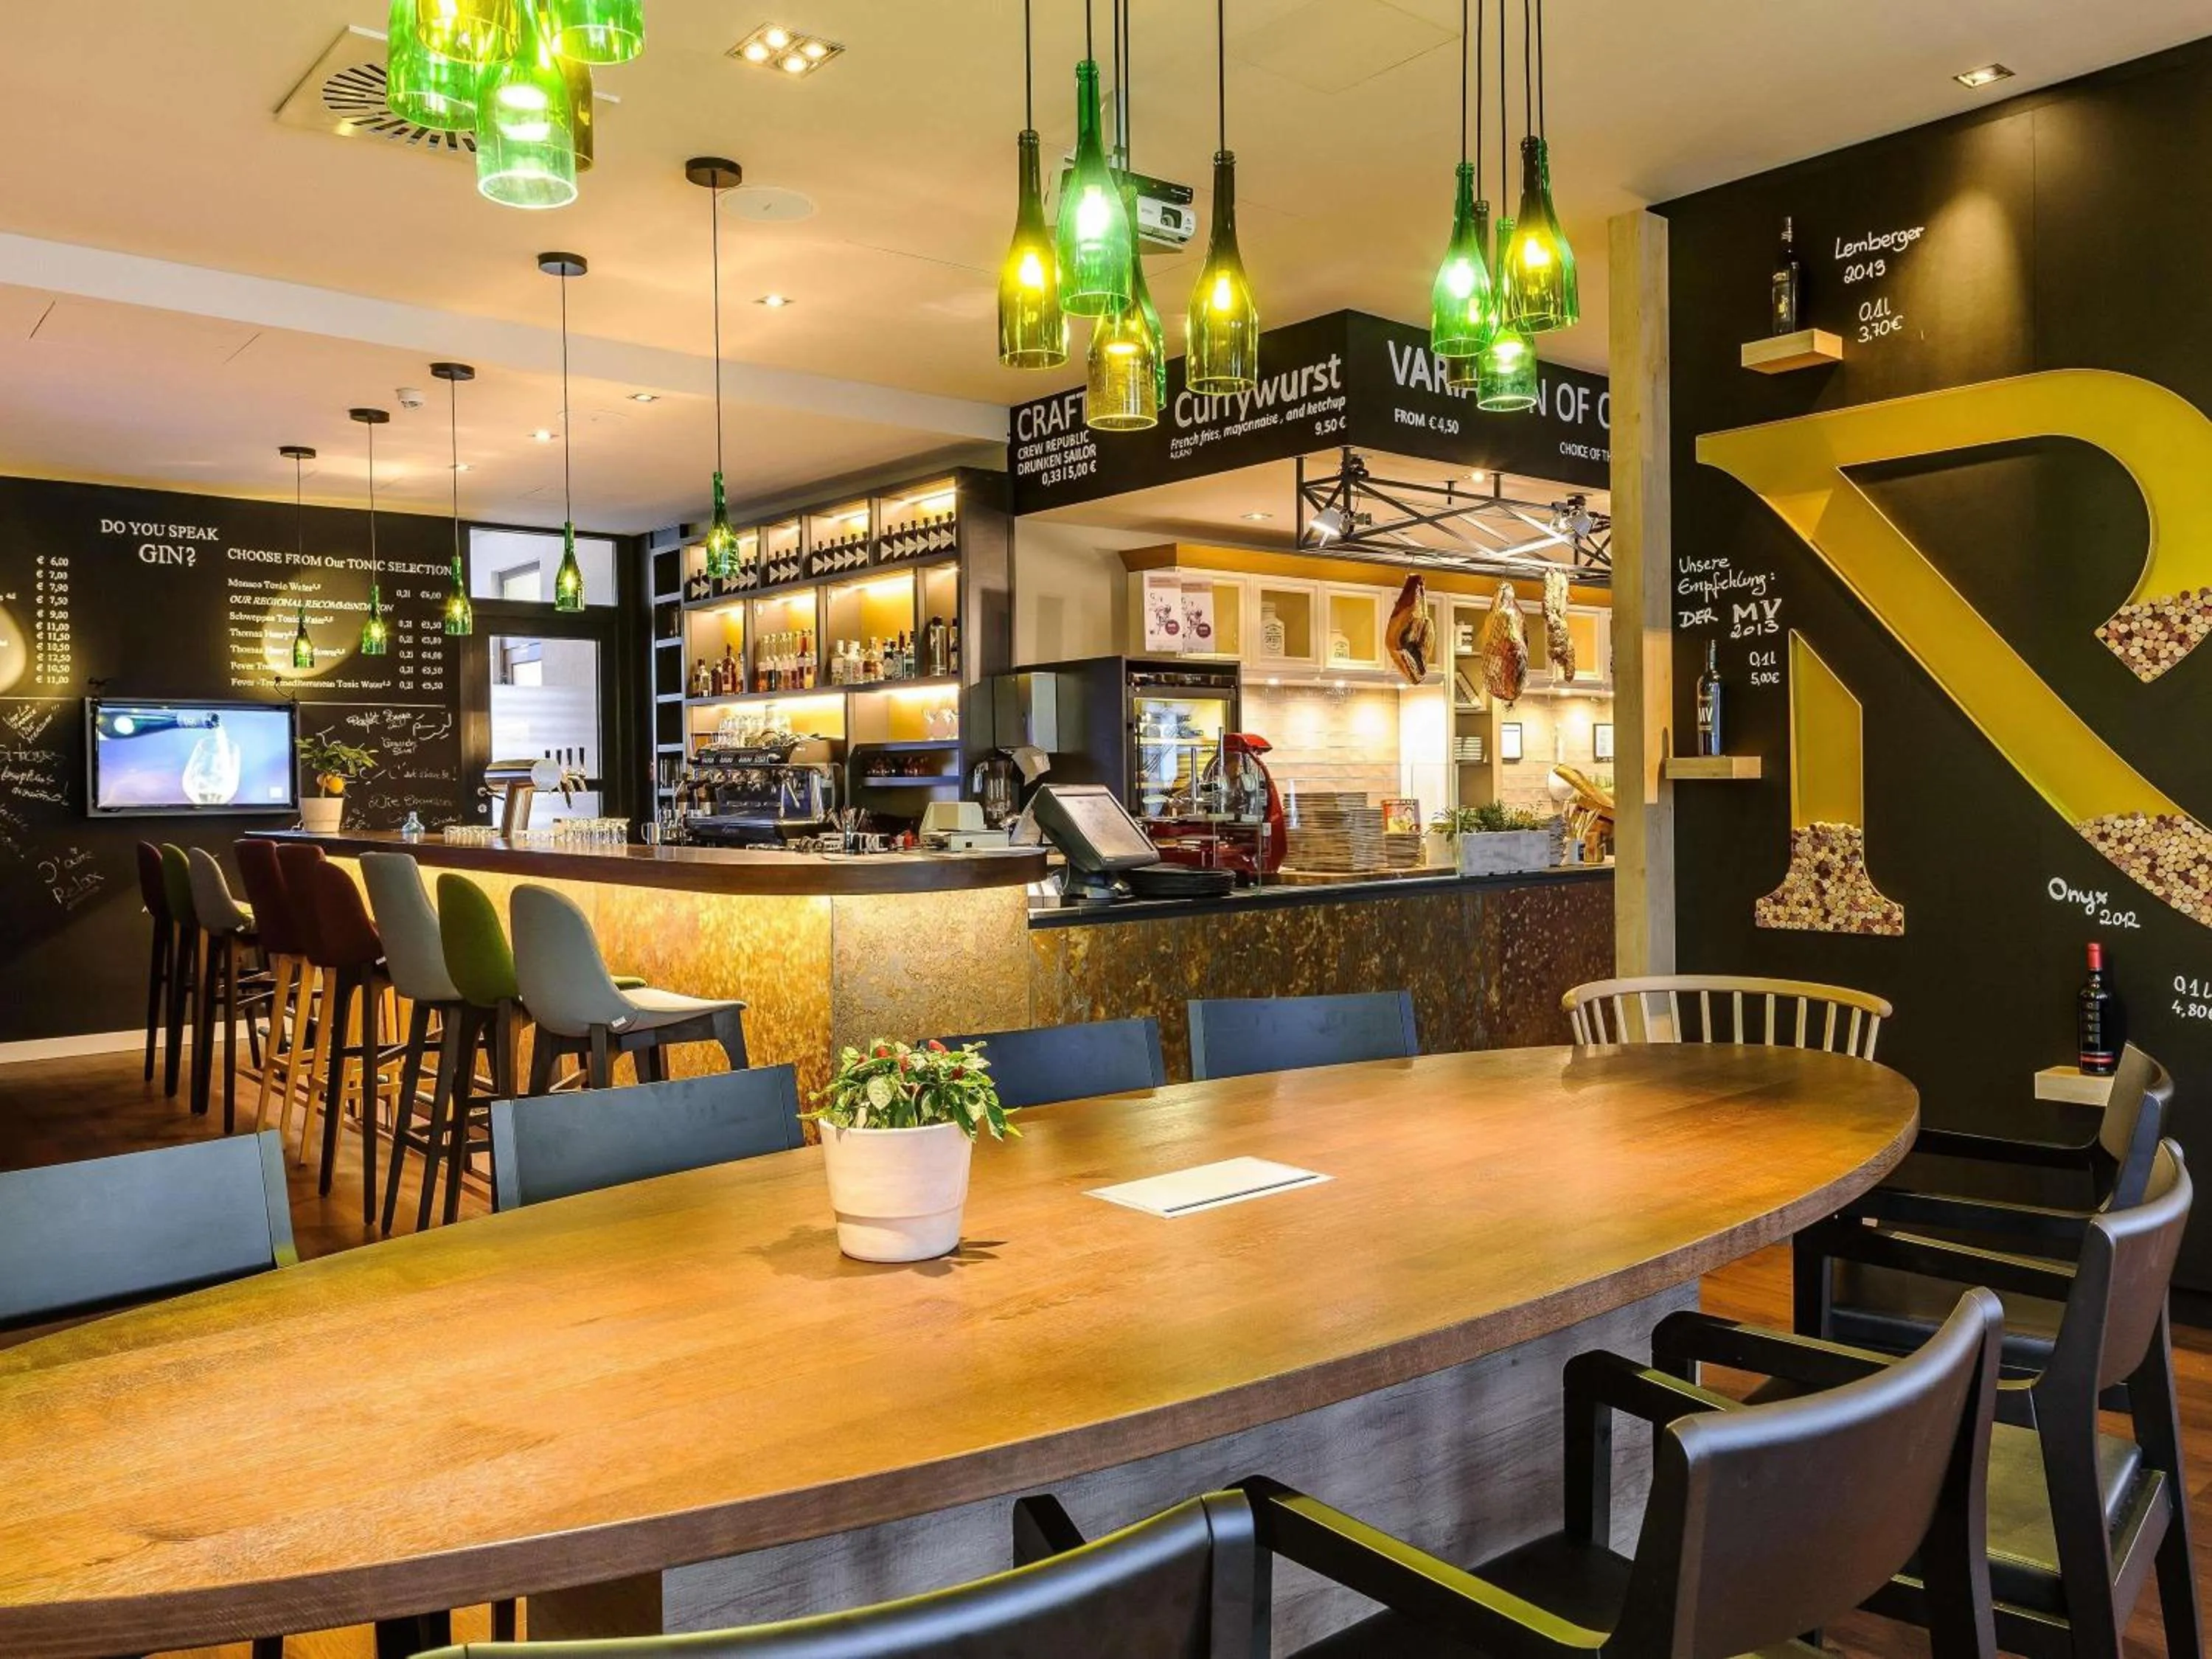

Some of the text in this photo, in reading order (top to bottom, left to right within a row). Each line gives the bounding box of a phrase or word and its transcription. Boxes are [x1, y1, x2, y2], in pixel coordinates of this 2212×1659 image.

[1834, 226, 1925, 260] Lemberger
[1844, 259, 1886, 283] 2013
[1174, 352, 1342, 428] Currywurst
[1017, 390, 1088, 442] CRAFT
[1557, 383, 1590, 425] OF
[1169, 432, 1199, 451] French
[1200, 428, 1221, 447] fries,
[1285, 403, 1305, 422] and
[1307, 395, 1346, 416] ketchup
[1315, 415, 1346, 436] 9,50 €
[1394, 408, 1425, 428] FROM
[1018, 430, 1090, 461] CREW REPUBLIC
[1559, 441, 1588, 459] CHOICE
[1589, 447, 1601, 461] OF
[1017, 444, 1097, 476] DRUNKEN SAILOR
[1042, 468, 1061, 487] 0,33
[1068, 463, 1088, 480] 5,00
[1089, 459, 1097, 473] €
[101, 519, 219, 541] DO YOU SPEAK
[139, 543, 197, 567] GIN?
[227, 548, 282, 564] CHOOSE
[285, 553, 322, 567] FROM
[324, 557, 347, 569] Our
[387, 560, 452, 577] SELECTION
[1678, 555, 1731, 574] Unsere
[229, 594, 394, 613] OUR REGIONAL RECOMMENDAON
[1678, 598, 1783, 628] DER MV
[229, 627, 262, 639] Thomas
[1730, 620, 1779, 639] 2013
[2048, 877, 2109, 914] Onyx
[2099, 908, 2140, 928] 2012
